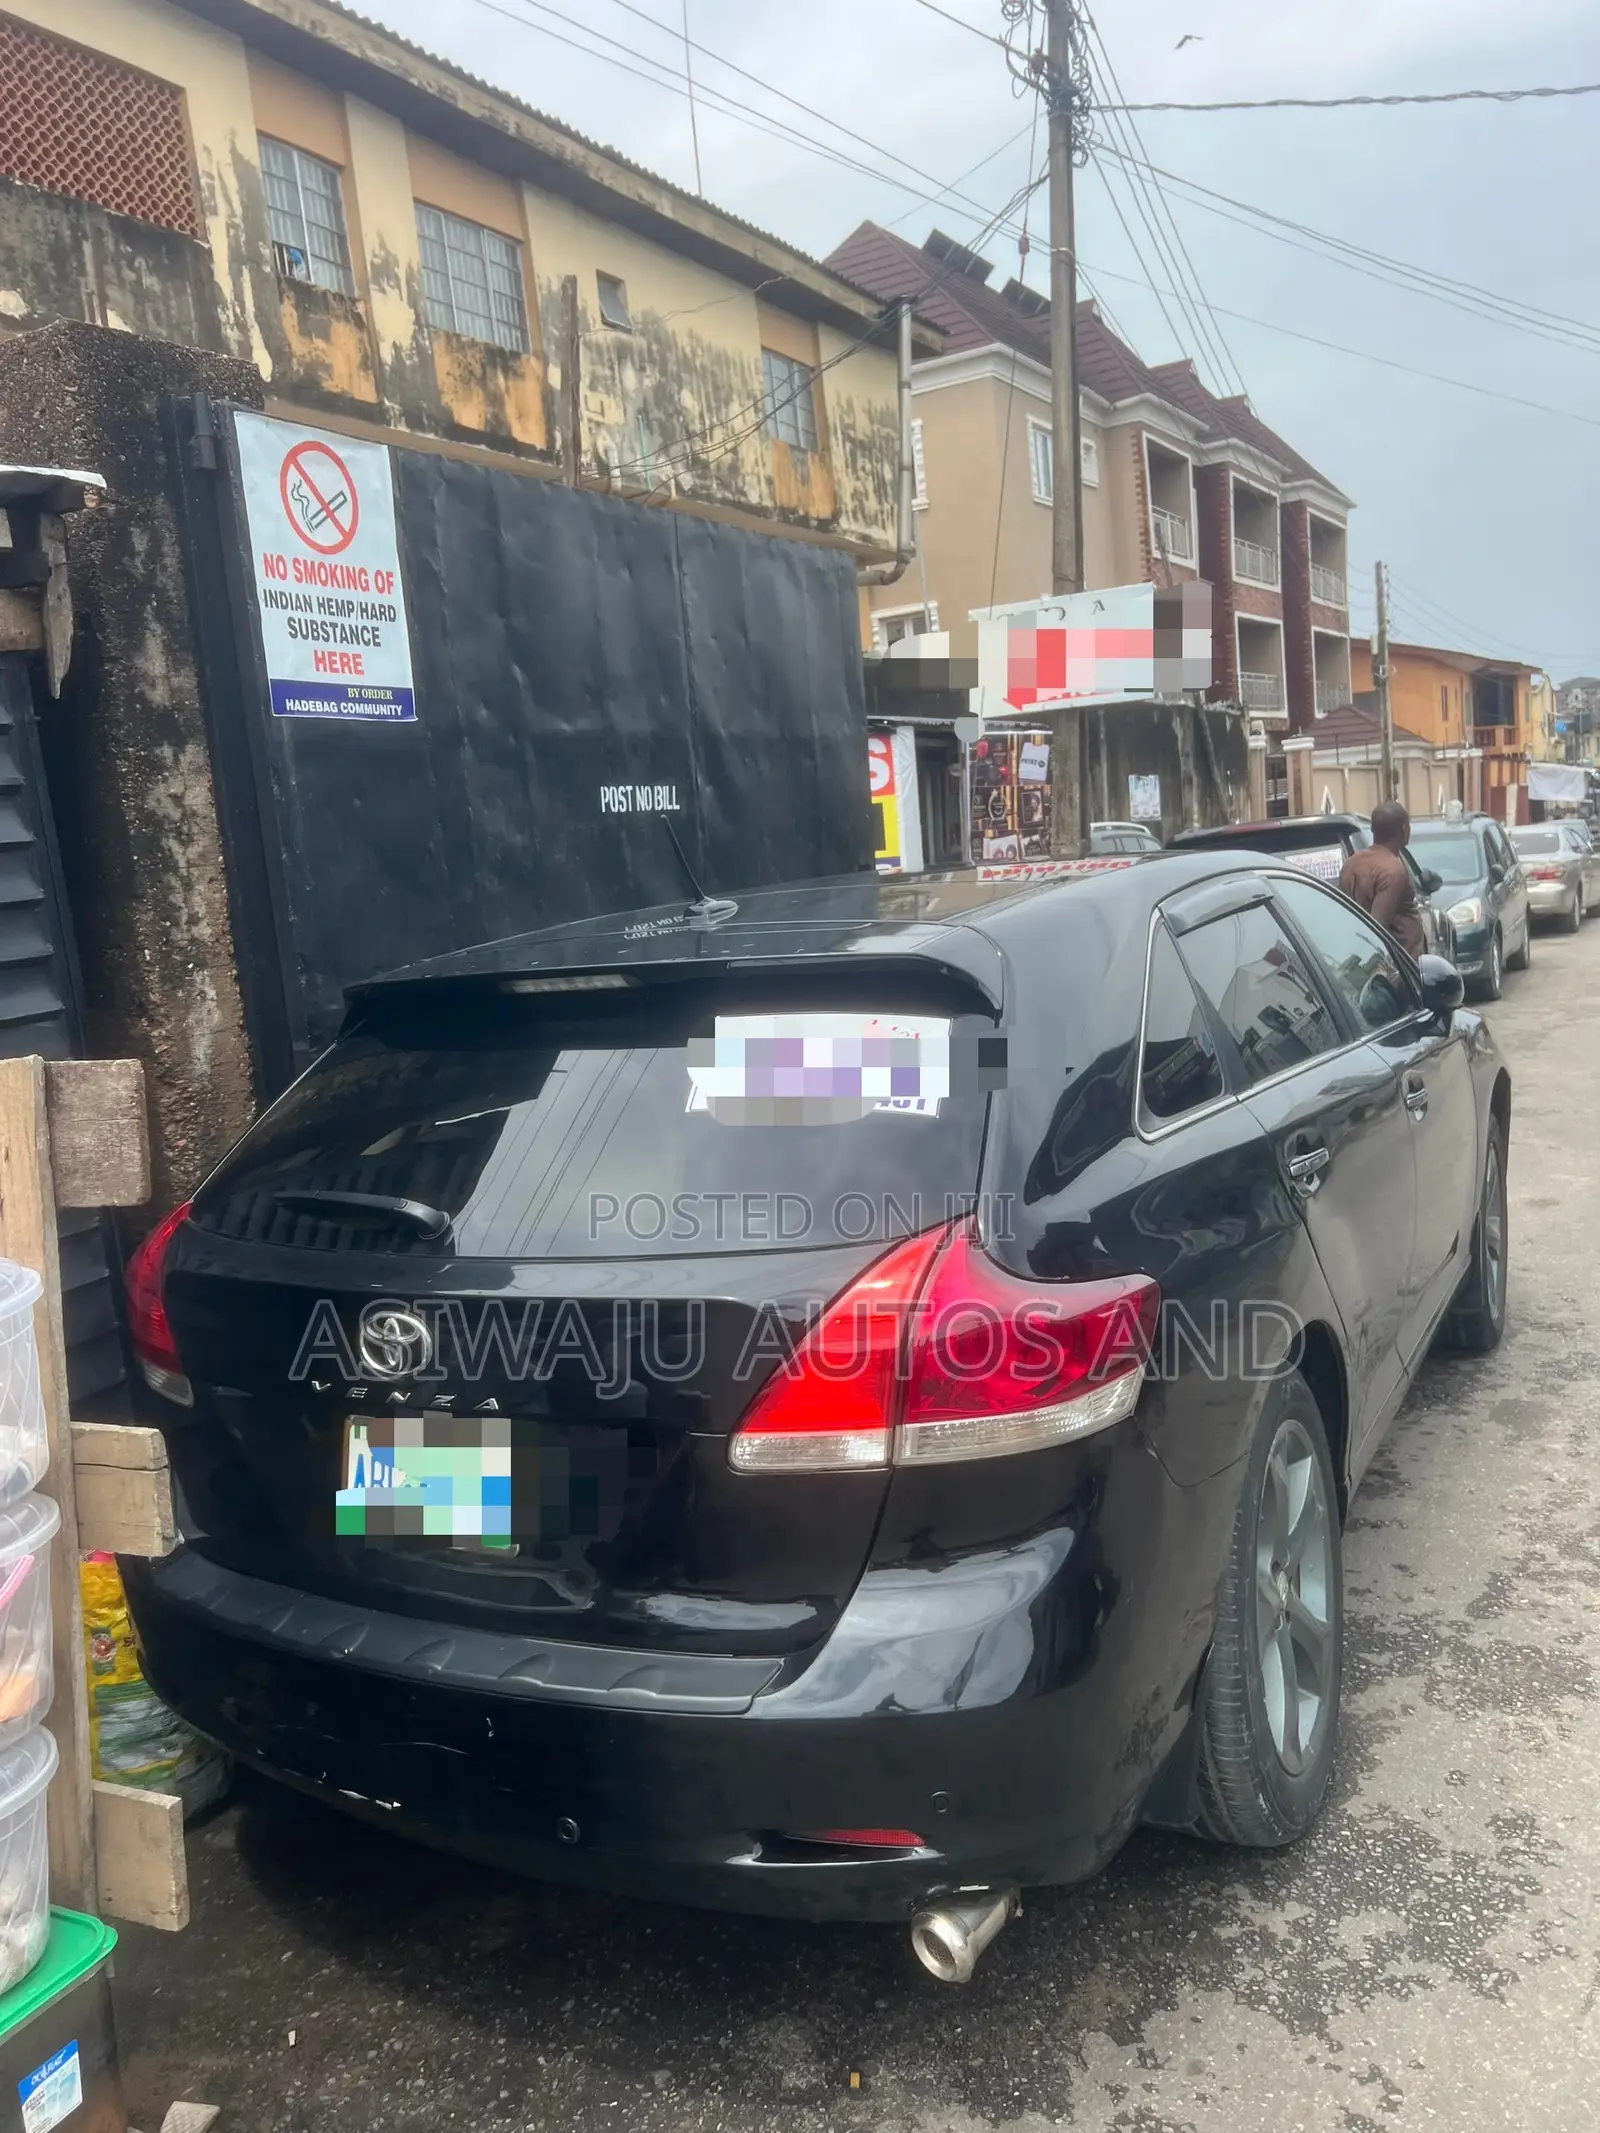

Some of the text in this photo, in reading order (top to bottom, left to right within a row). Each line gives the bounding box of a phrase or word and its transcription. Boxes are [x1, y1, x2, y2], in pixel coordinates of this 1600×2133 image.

[263, 553, 394, 595] NO SMOKING OF
[263, 589, 397, 622] INDIAN HEMP/HARD
[288, 616, 381, 647] SUBSTANCE
[314, 649, 364, 675] HERE
[285, 699, 402, 716] HADEBAG COMMUNITY
[347, 687, 393, 700] BY ORDER
[600, 785, 680, 813] POST NO BILL
[311, 1379, 500, 1411] VENZA
